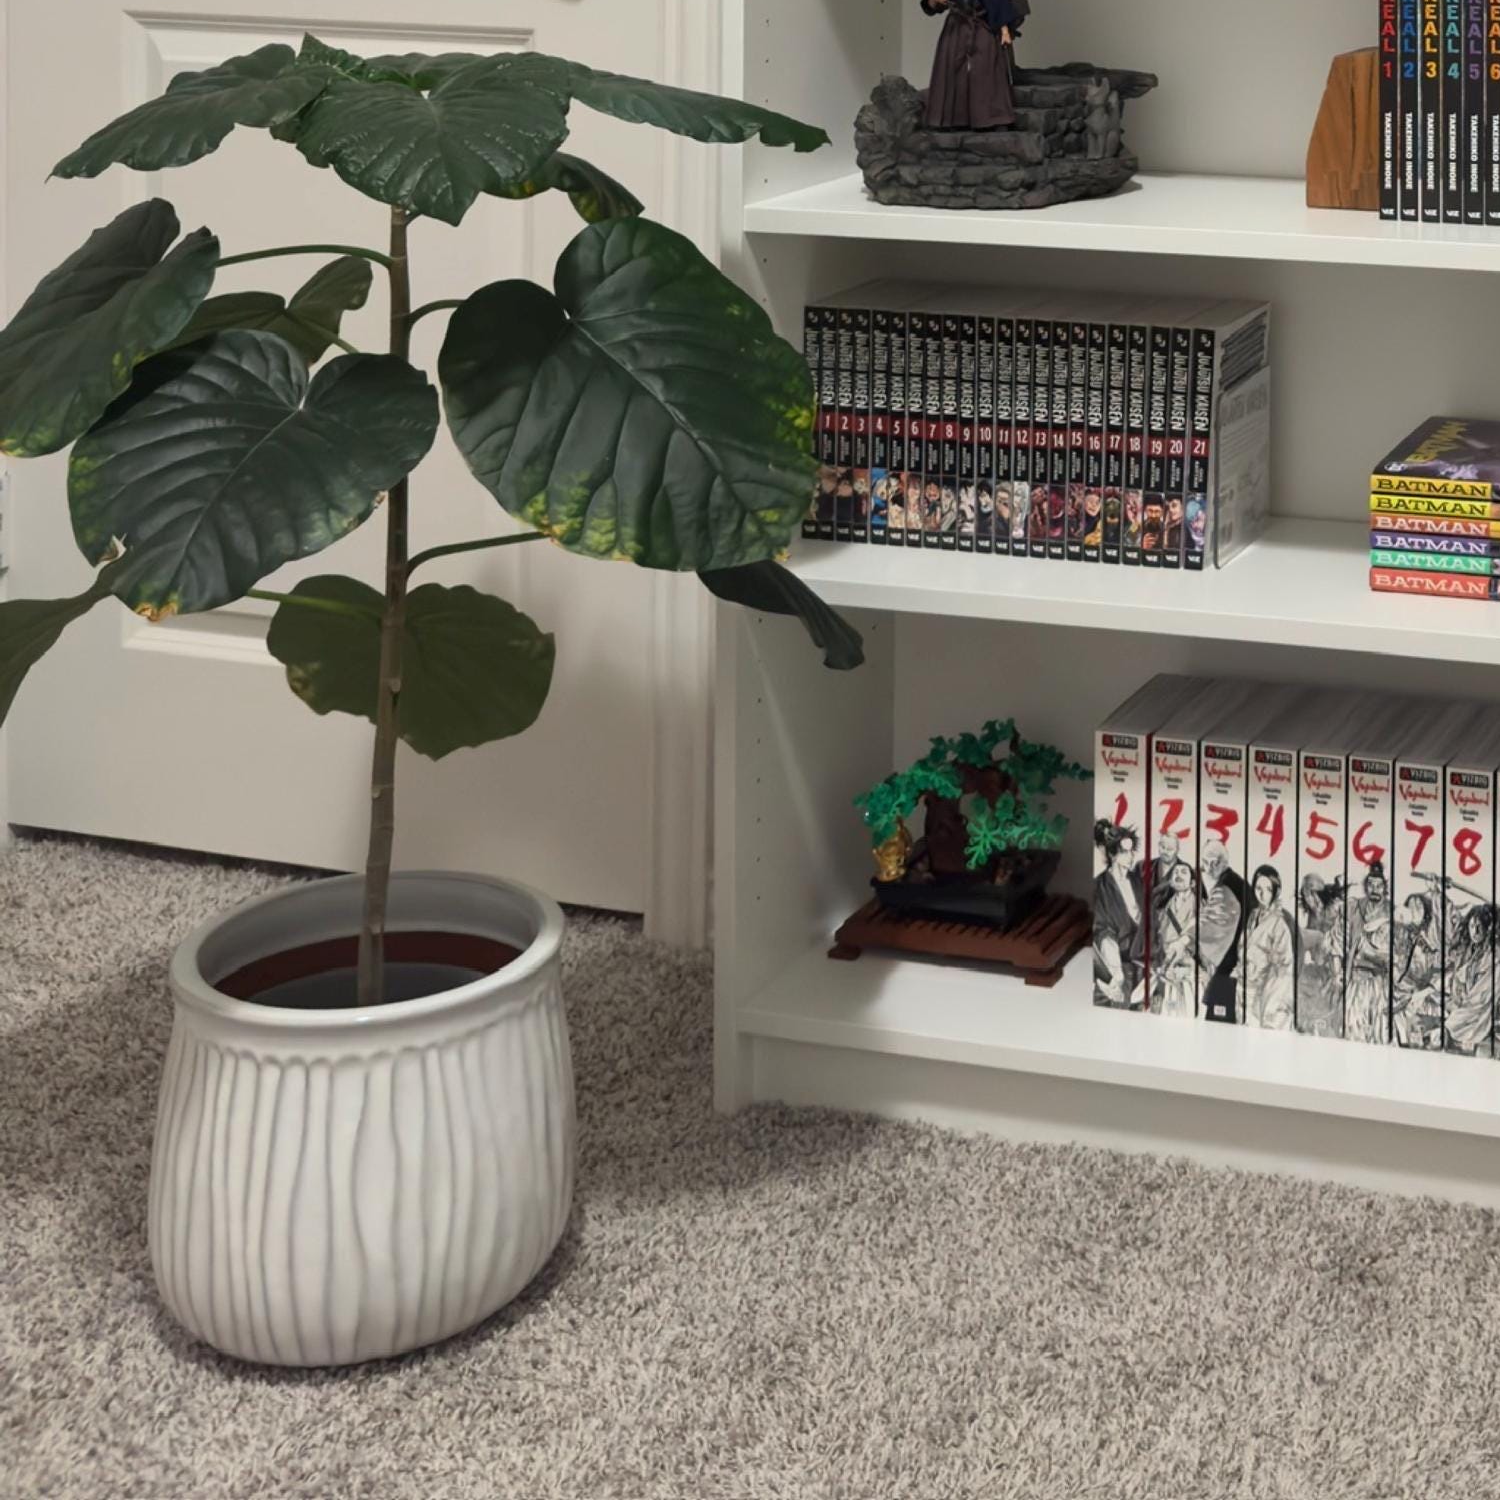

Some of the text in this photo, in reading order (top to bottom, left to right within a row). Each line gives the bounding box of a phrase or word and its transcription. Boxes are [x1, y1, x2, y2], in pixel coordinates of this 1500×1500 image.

[1383, 62, 1392, 78] 1
[1403, 62, 1414, 78] 2
[1426, 62, 1437, 78] 3
[1448, 63, 1460, 78] 4
[1470, 64, 1480, 79] 5
[1490, 63, 1500, 80] 6
[1384, 112, 1392, 190] TAKEHIKO INOUE
[826, 415, 830, 426] 1
[1195, 394, 1209, 432] KAISEN
[842, 416, 849, 430] 2
[858, 419, 864, 431] 3
[876, 418, 882, 430] 4
[894, 420, 900, 434] 5
[911, 422, 918, 435] 6
[929, 424, 936, 437] 7
[946, 425, 952, 437] 8
[964, 428, 970, 442] 9
[980, 428, 990, 442] 10
[1000, 430, 1008, 443] 11
[1017, 430, 1027, 444] 12
[1036, 433, 1046, 446] 13
[1053, 434, 1064, 448] 14
[1072, 432, 1082, 446] 15
[1090, 436, 1100, 449] 16
[1110, 435, 1120, 448] 17
[1130, 438, 1140, 451] 18
[1152, 440, 1162, 454] 19
[1170, 440, 1182, 454] 20
[1194, 440, 1206, 454] 21
[1377, 478, 1488, 497] BATMAN
[1376, 498, 1486, 516] BATMAN
[1375, 516, 1488, 536] BATMAN
[1374, 535, 1486, 554] BATMAN
[1376, 553, 1485, 572] BATMAN
[1374, 574, 1486, 594] BATMAN
[1102, 750, 1139, 767] Vagabond
[1155, 756, 1192, 774] Vagabond
[1204, 761, 1242, 779] Vagabond
[1254, 765, 1292, 784] Vagabond
[1304, 771, 1342, 790] Vagabond
[1352, 775, 1389, 794] Vagabond
[1400, 784, 1438, 801] Vagabond
[1450, 790, 1490, 806] Vagabond
[1114, 792, 1128, 827] 1
[1158, 798, 1191, 839] 2
[1206, 803, 1239, 846] 3
[1256, 803, 1284, 857] 4
[1306, 810, 1338, 860] 5
[1352, 821, 1386, 866] 6
[1404, 820, 1434, 869] 7
[1452, 828, 1482, 876] 8
